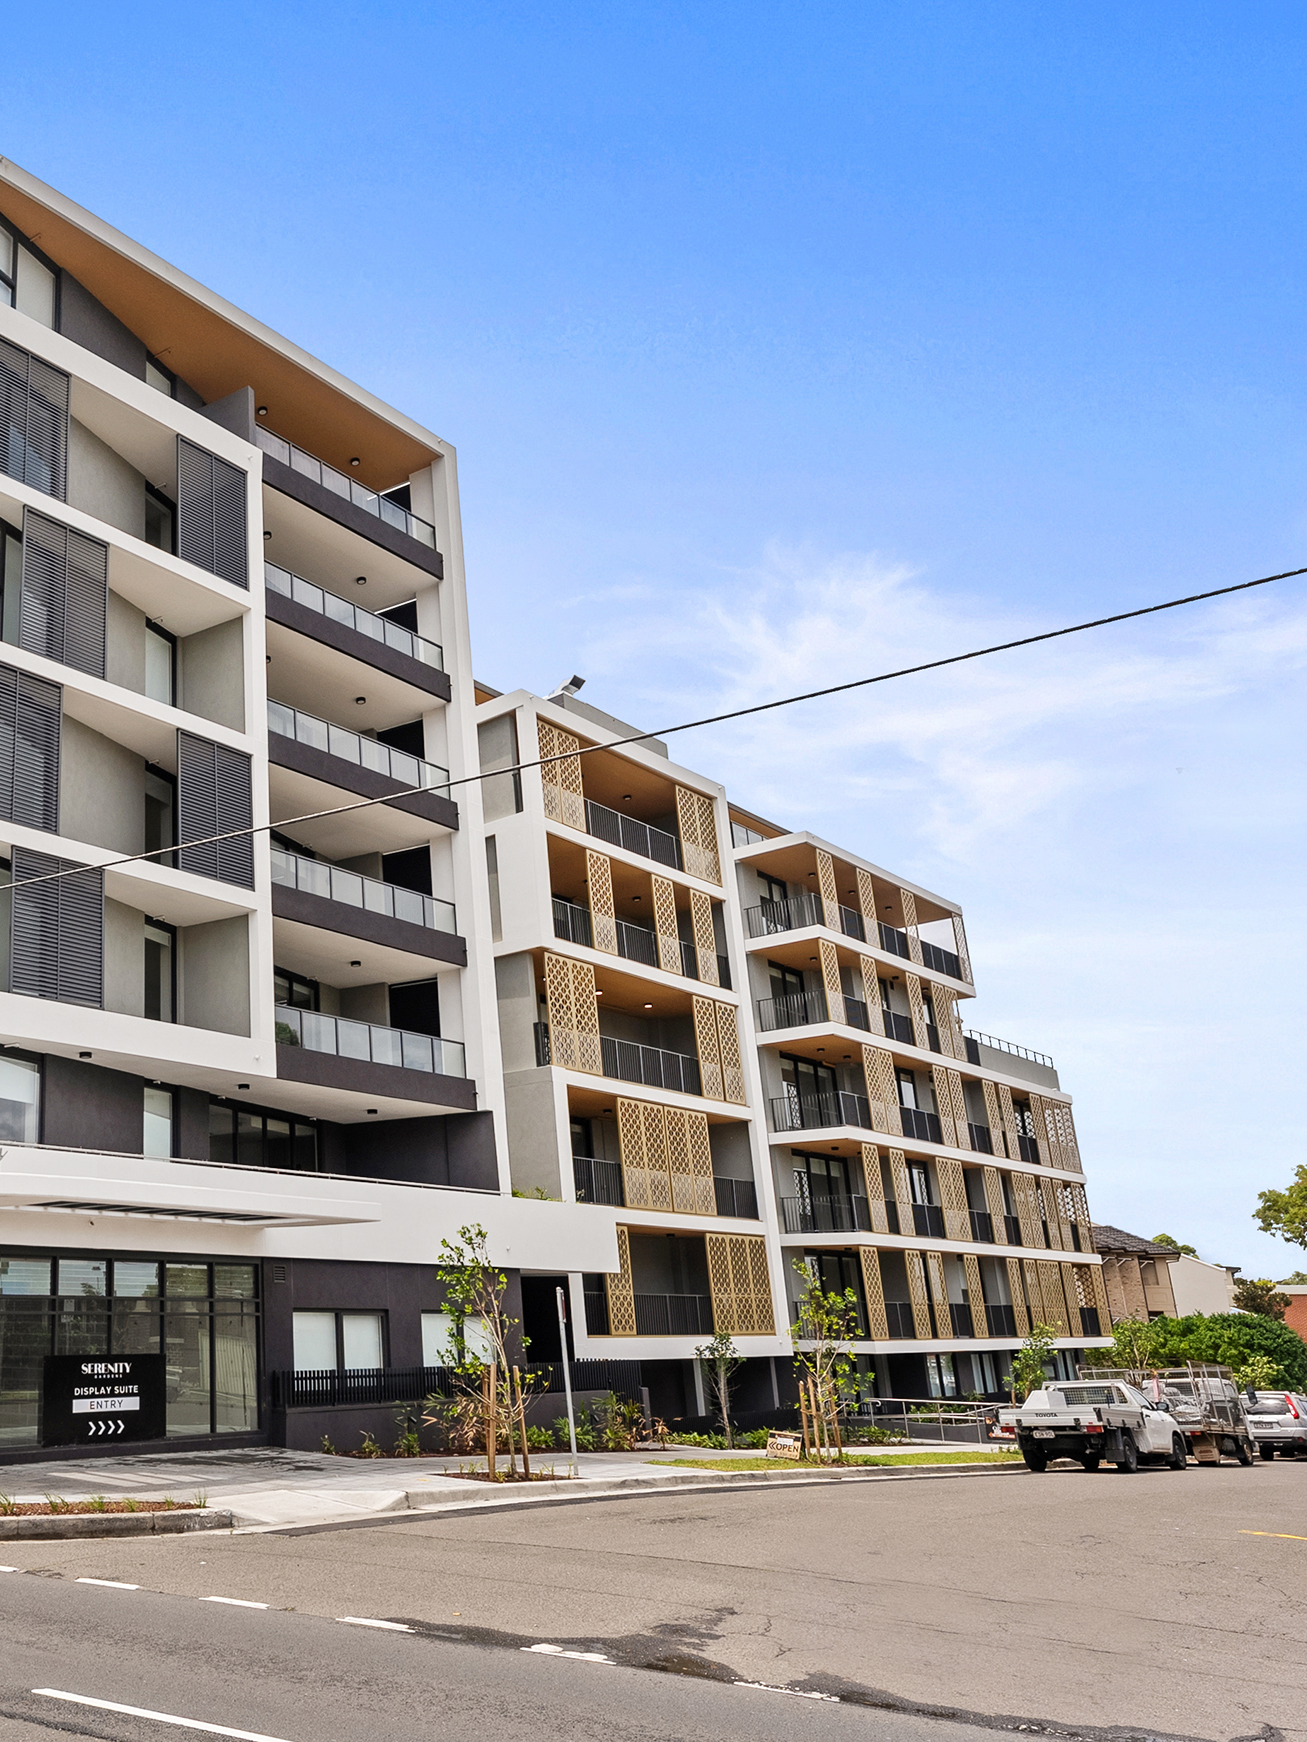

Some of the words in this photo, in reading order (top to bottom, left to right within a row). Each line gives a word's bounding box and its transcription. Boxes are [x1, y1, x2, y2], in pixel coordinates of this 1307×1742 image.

[81, 1362, 132, 1375] SERENITY
[74, 1386, 112, 1396] DISPLAY
[114, 1385, 139, 1394] SUITE
[90, 1399, 123, 1410] ENTRY
[776, 1443, 799, 1453] OPEN
